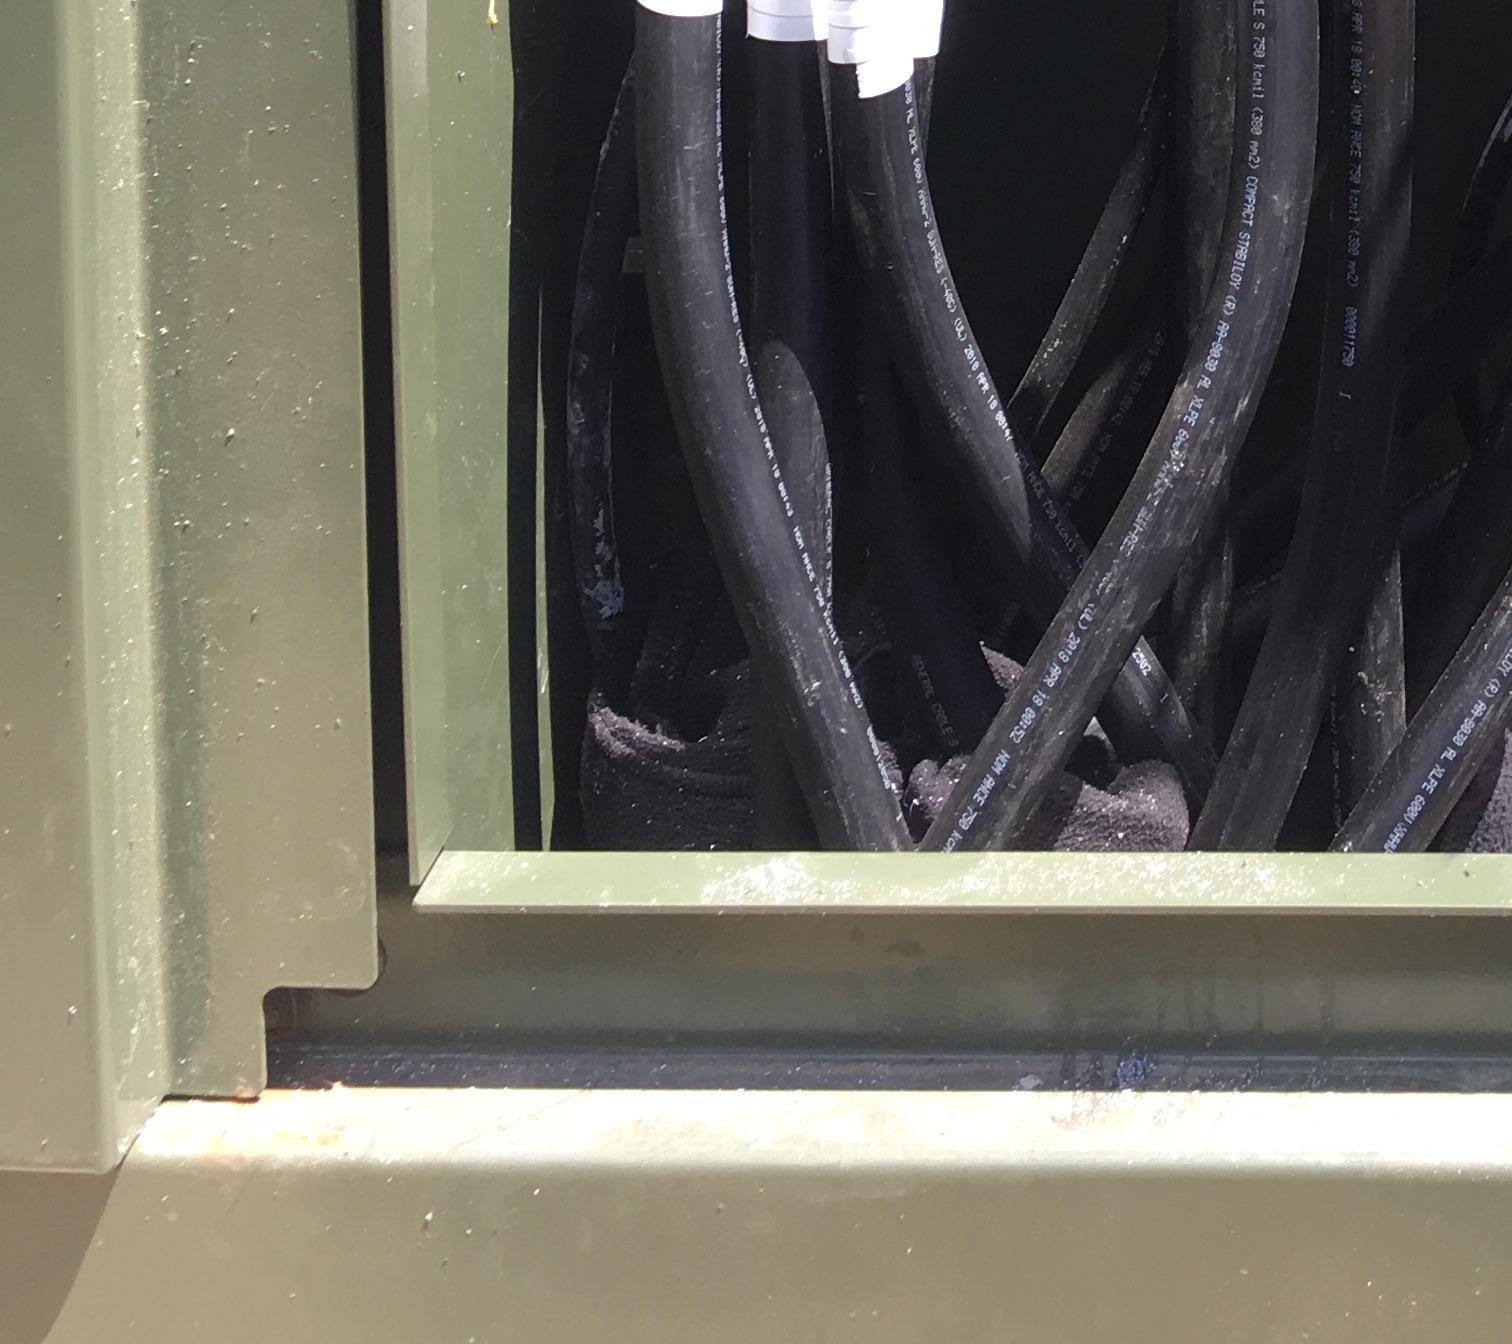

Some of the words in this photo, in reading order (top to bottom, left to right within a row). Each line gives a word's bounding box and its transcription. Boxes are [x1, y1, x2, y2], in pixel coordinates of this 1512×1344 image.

[1252, 36, 1265, 58] 750
[1241, 175, 1258, 228] COMPACT
[1229, 231, 1251, 290] STABILOY
[1196, 374, 1212, 390] AL
[1183, 394, 1205, 427] XLPE
[1043, 663, 1061, 687] APR
[1441, 746, 1457, 762] AL
[1421, 764, 1446, 794] XLPE
